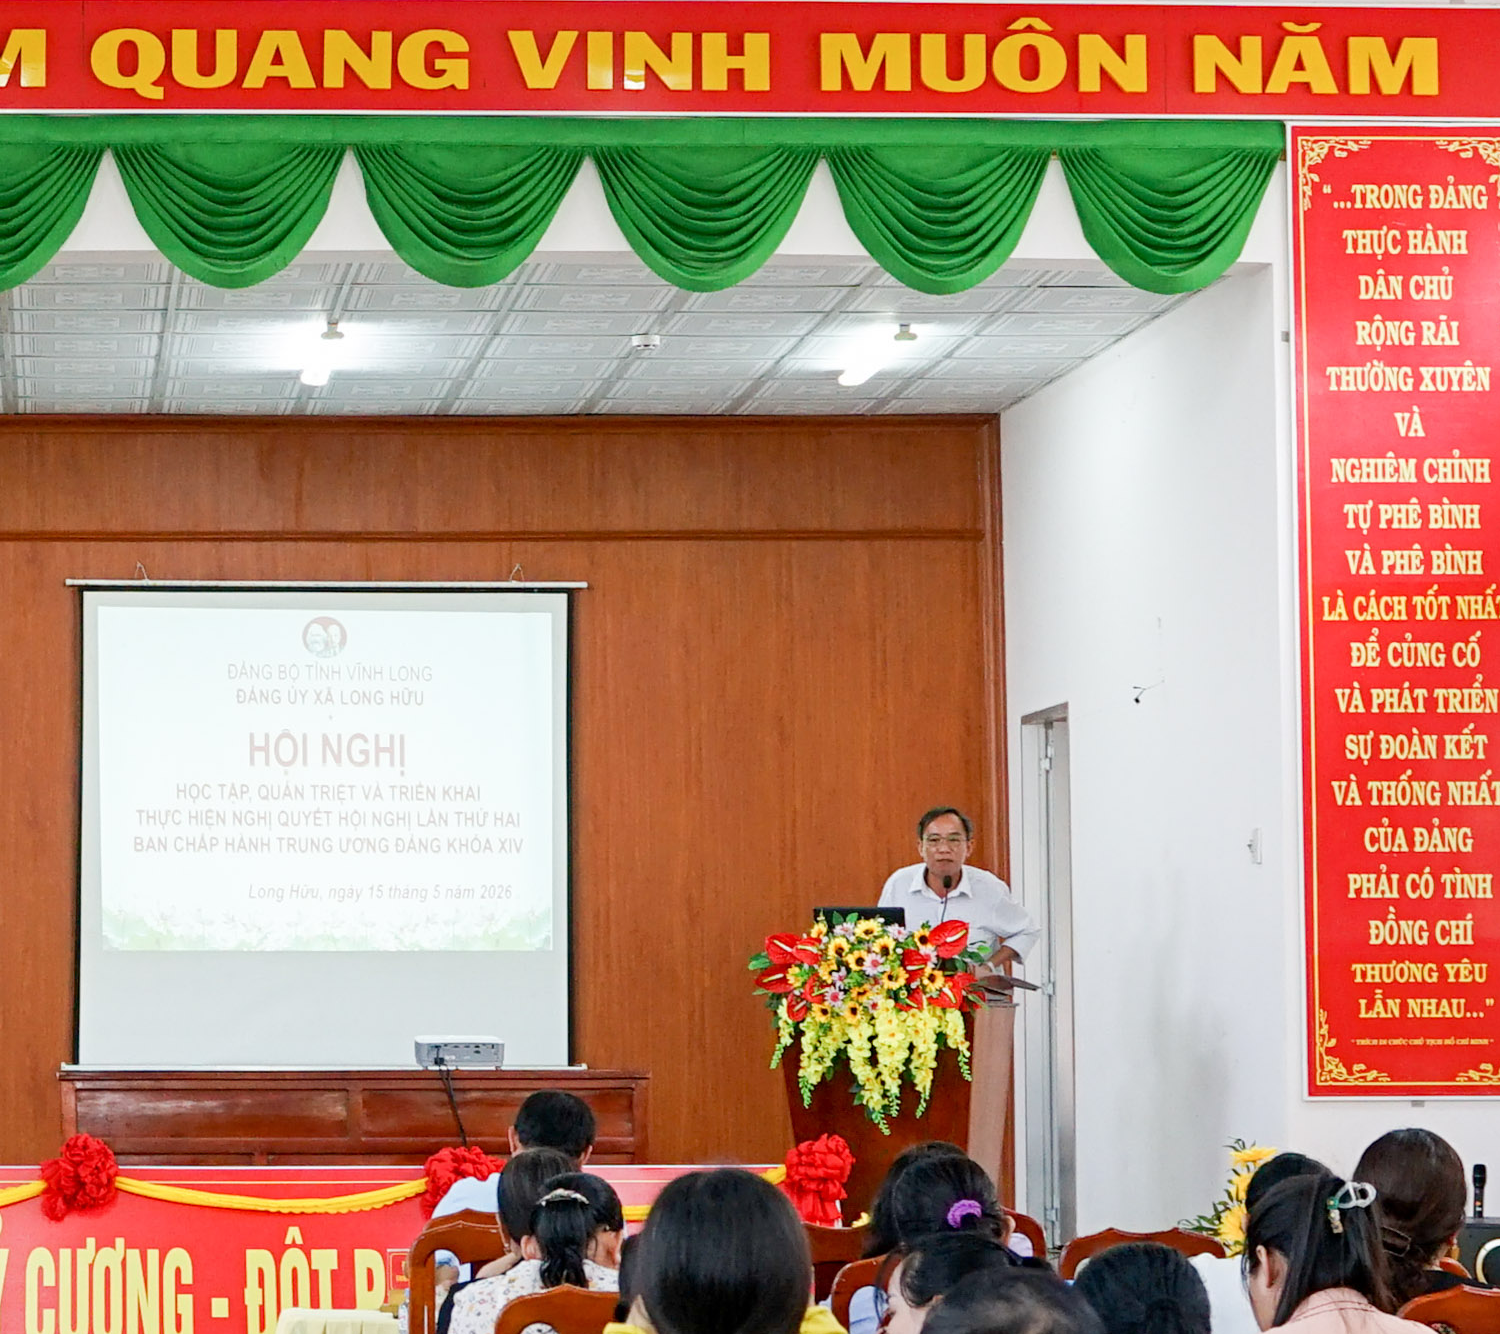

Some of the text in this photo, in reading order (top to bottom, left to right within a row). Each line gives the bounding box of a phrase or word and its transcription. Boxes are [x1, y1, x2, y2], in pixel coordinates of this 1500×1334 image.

[91, 29, 469, 99] QUANG
[508, 31, 770, 90] VINH
[821, 18, 1147, 92] MUÔN
[1193, 17, 1441, 97] NĂM
[1322, 590, 1348, 620] LÀ
[1353, 589, 1407, 621] CÁCH
[1412, 584, 1450, 620] TỐT
[1350, 628, 1481, 667] ĐỂ CỦNG CỐ
[1335, 674, 1499, 713] VÀ PHÁT TRIỂN
[1345, 723, 1488, 765] SỰ ĐOÀN KẾT
[1331, 774, 1362, 805] VÀ
[1368, 769, 1441, 806] THỐNG
[1364, 818, 1473, 852] CỦA ĐẢNG
[1348, 864, 1493, 899] PHẢI CÓ TÌNH
